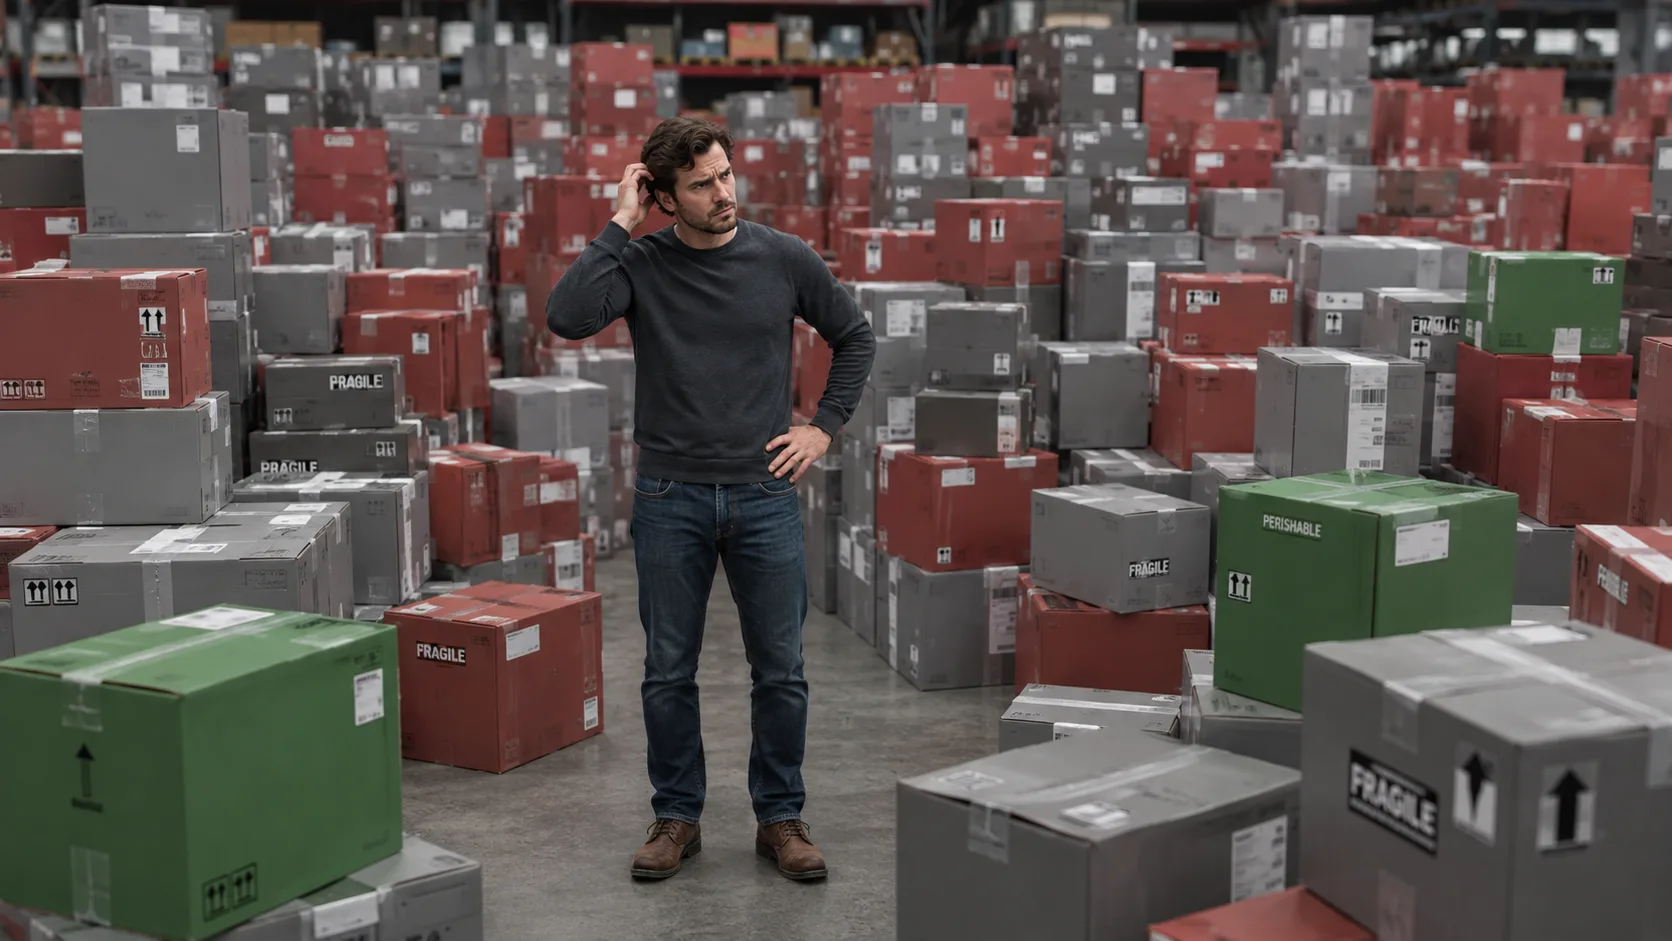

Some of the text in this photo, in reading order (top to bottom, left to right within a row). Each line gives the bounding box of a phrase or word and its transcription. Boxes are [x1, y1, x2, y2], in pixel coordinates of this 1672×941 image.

[1263, 514, 1322, 538] PERISHABLE
[1129, 560, 1169, 578] FRAGILE
[416, 643, 467, 664] FRAGILE
[1350, 762, 1438, 836] FRAGILE
